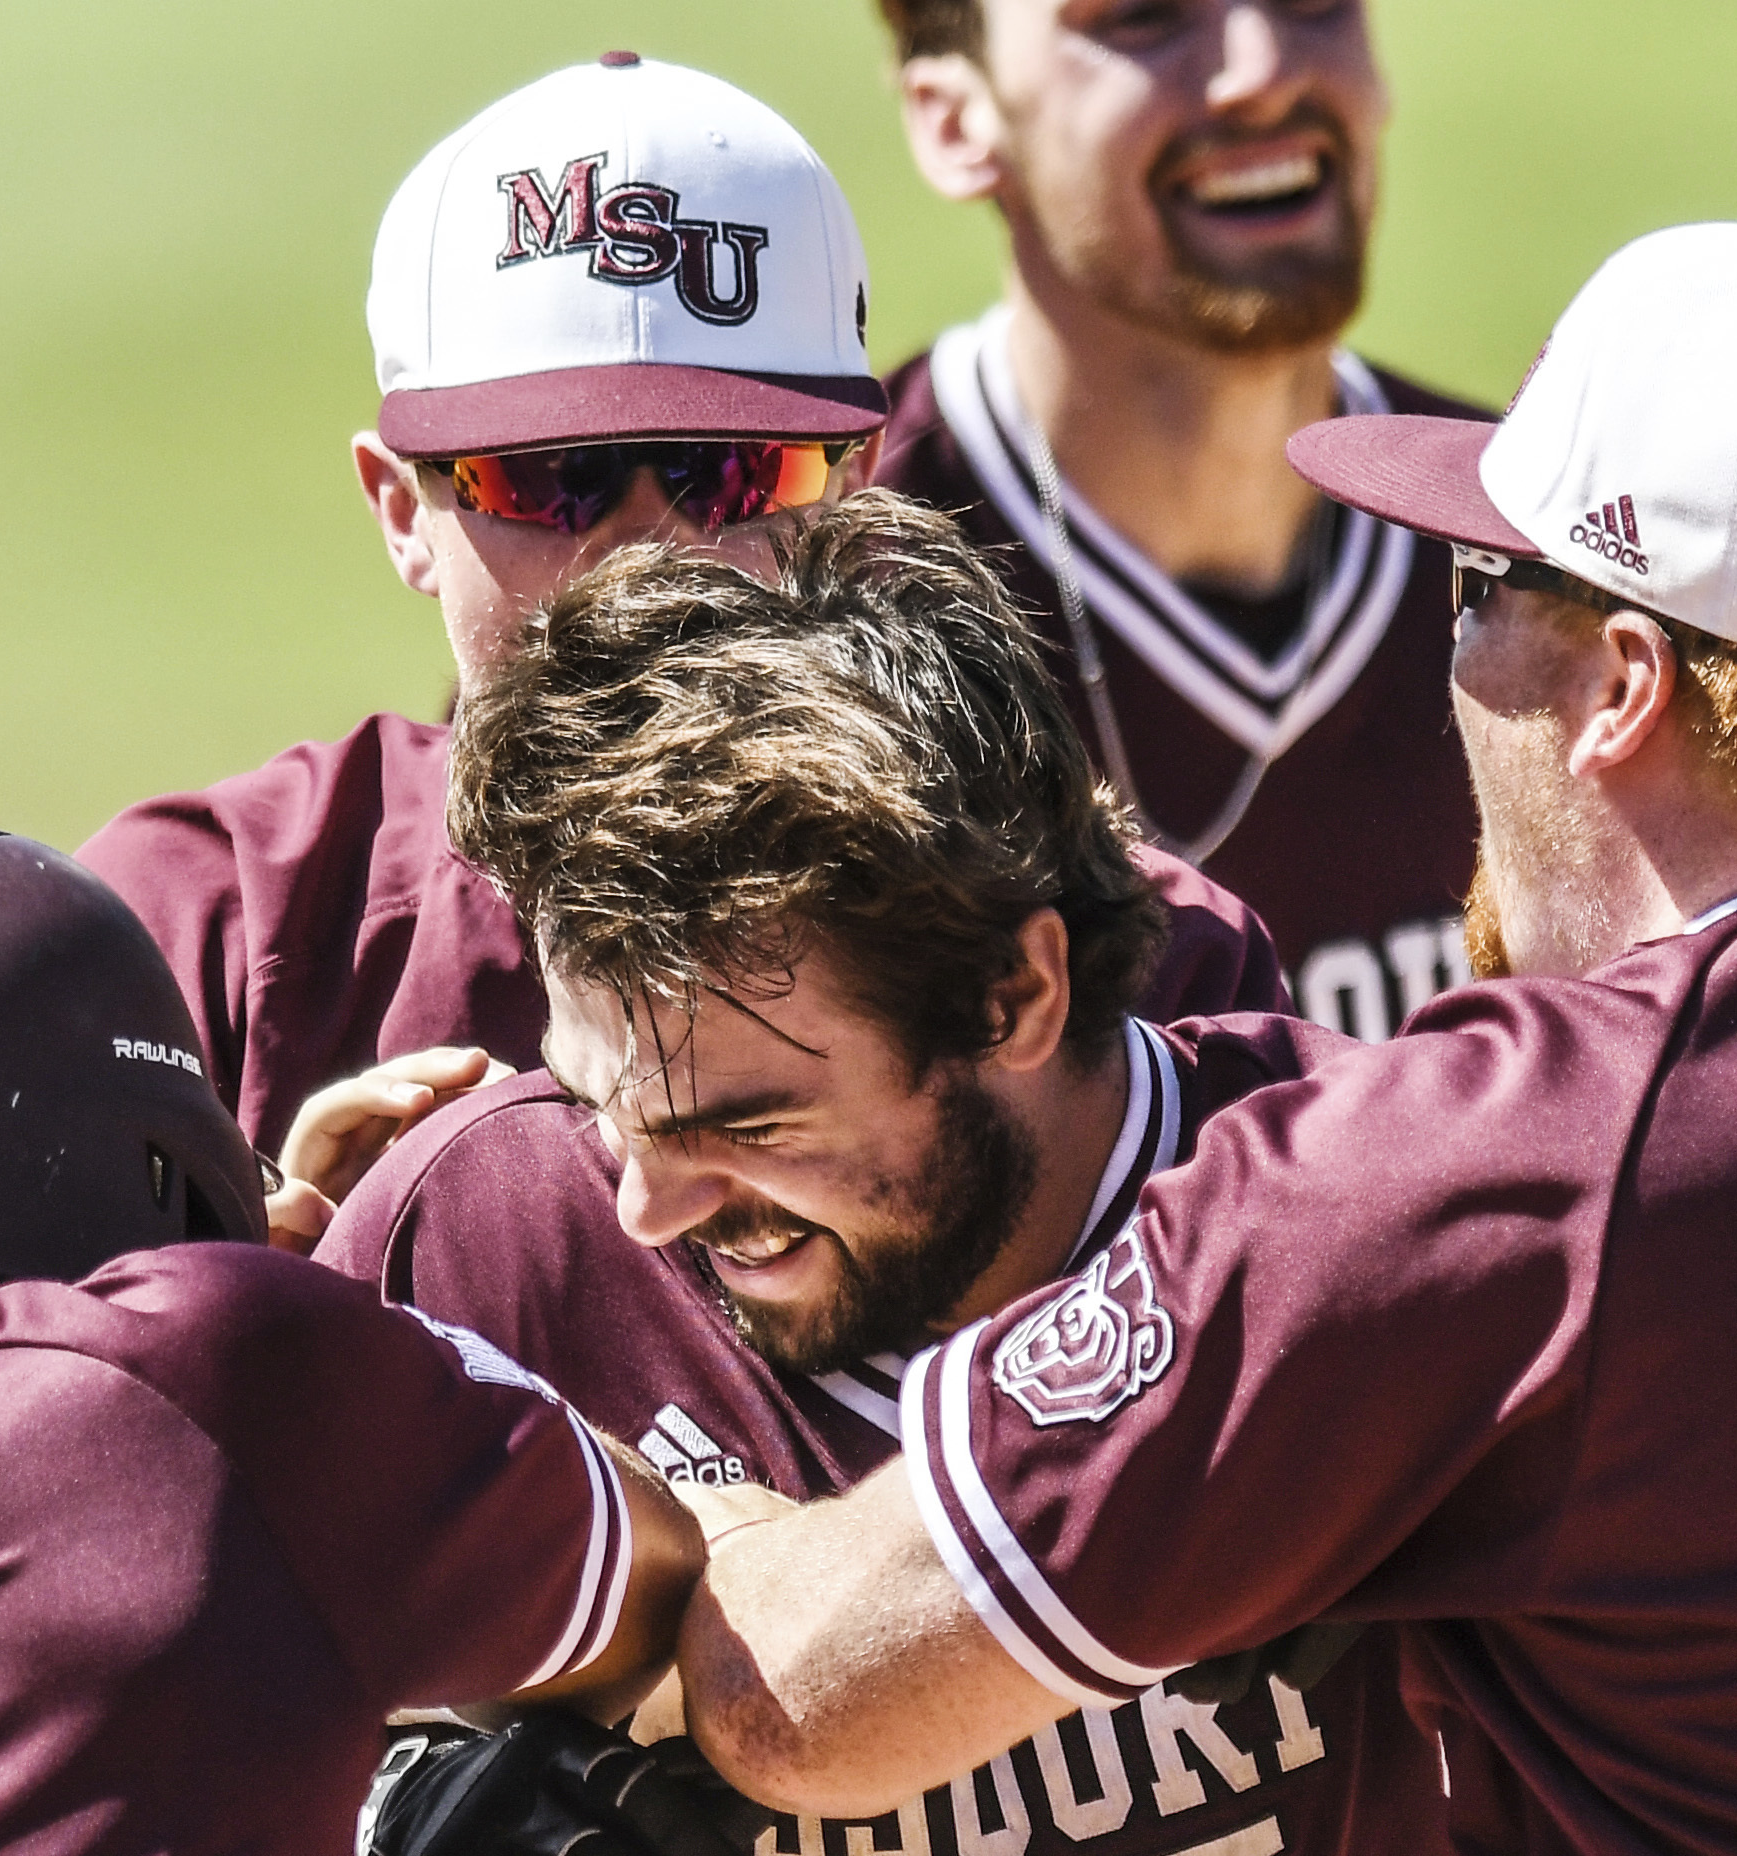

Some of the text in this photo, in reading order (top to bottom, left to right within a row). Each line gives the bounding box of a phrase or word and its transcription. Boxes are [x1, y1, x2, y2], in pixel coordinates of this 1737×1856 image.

[496, 150, 769, 327] MSU
[1569, 524, 1649, 576] adidas
[112, 1037, 204, 1079] RAWLINGS
